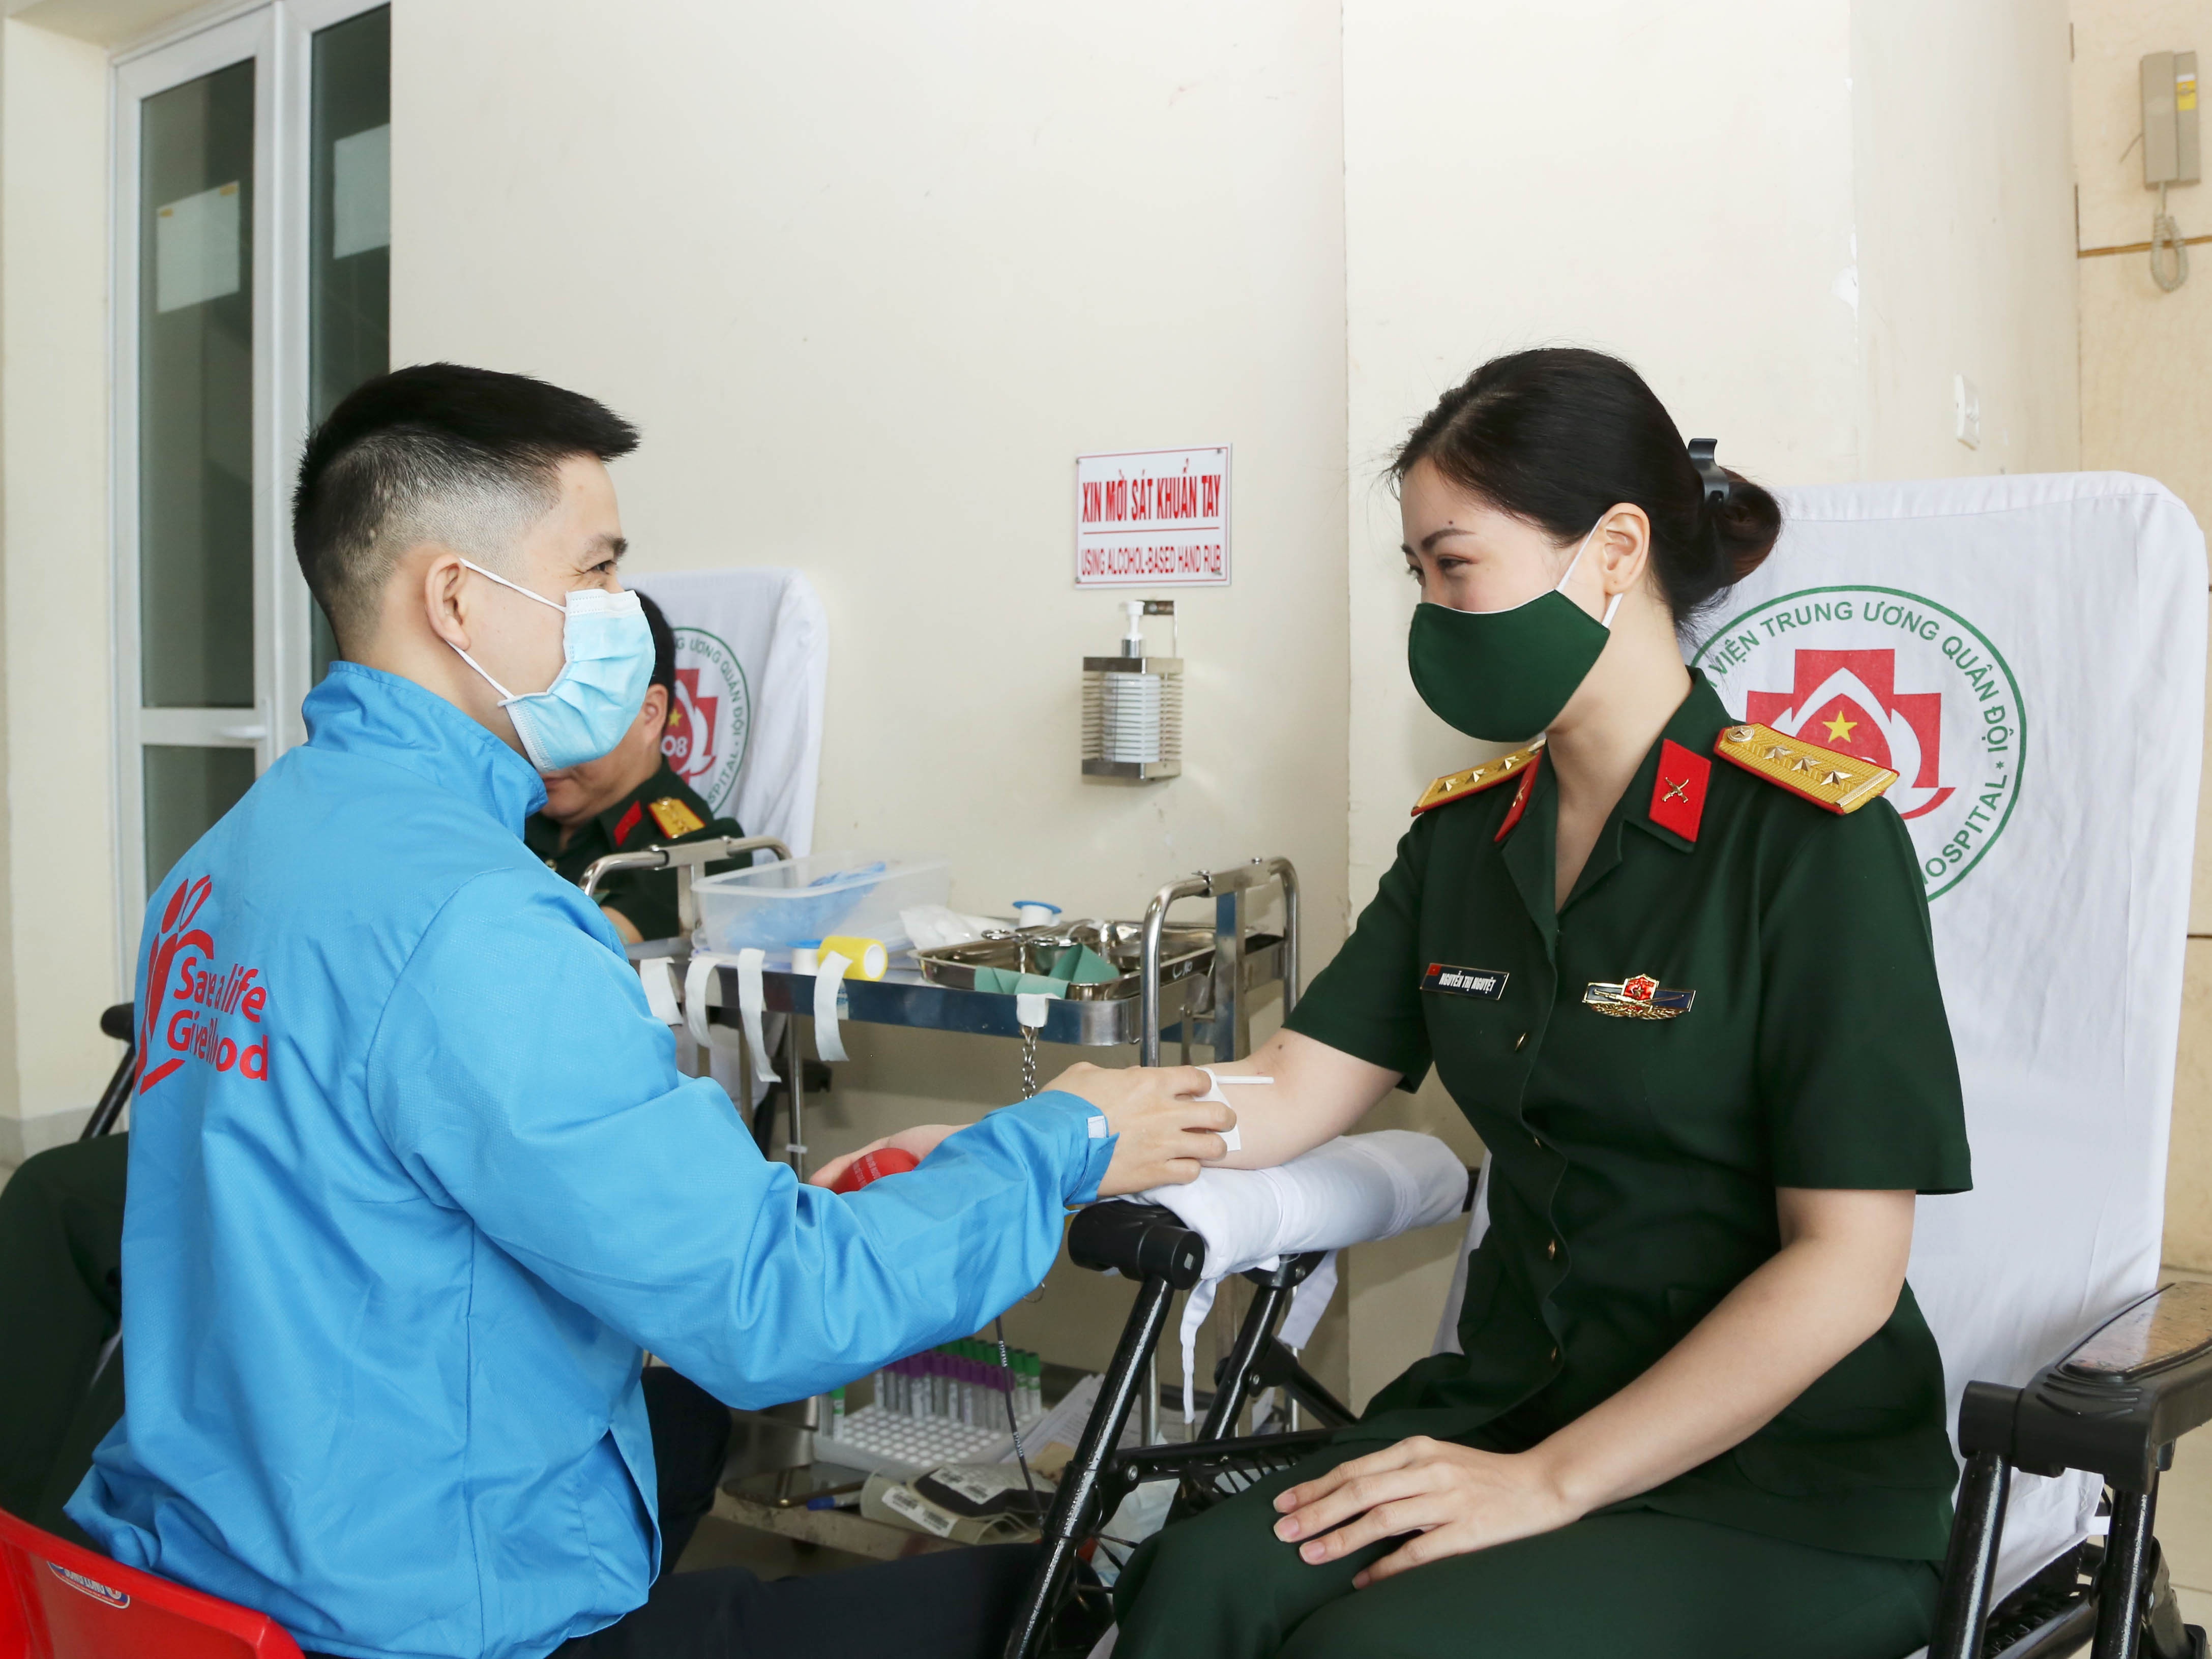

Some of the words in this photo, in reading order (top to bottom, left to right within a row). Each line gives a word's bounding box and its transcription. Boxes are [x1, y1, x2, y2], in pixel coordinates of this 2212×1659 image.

[1082, 481, 1102, 522] XIN
[1106, 469, 1127, 521] MỜI
[1132, 469, 1153, 520] SÁT
[1201, 475, 1221, 517] TAY
[1081, 548, 1105, 575] USING
[1177, 545, 1201, 573] HAND
[1204, 544, 1222, 572] RUB
[1708, 630, 1760, 674] VIỆN
[1760, 601, 1853, 639] TRUNG
[1863, 601, 1940, 640] ƯƠNG
[1941, 636, 2000, 702] QUÂN
[1982, 706, 2014, 753] ĐỘI
[661, 737, 688, 757] 08
[1921, 774, 2008, 884] OSPITAL
[173, 957, 217, 1008] Sae
[221, 963, 267, 1023] life
